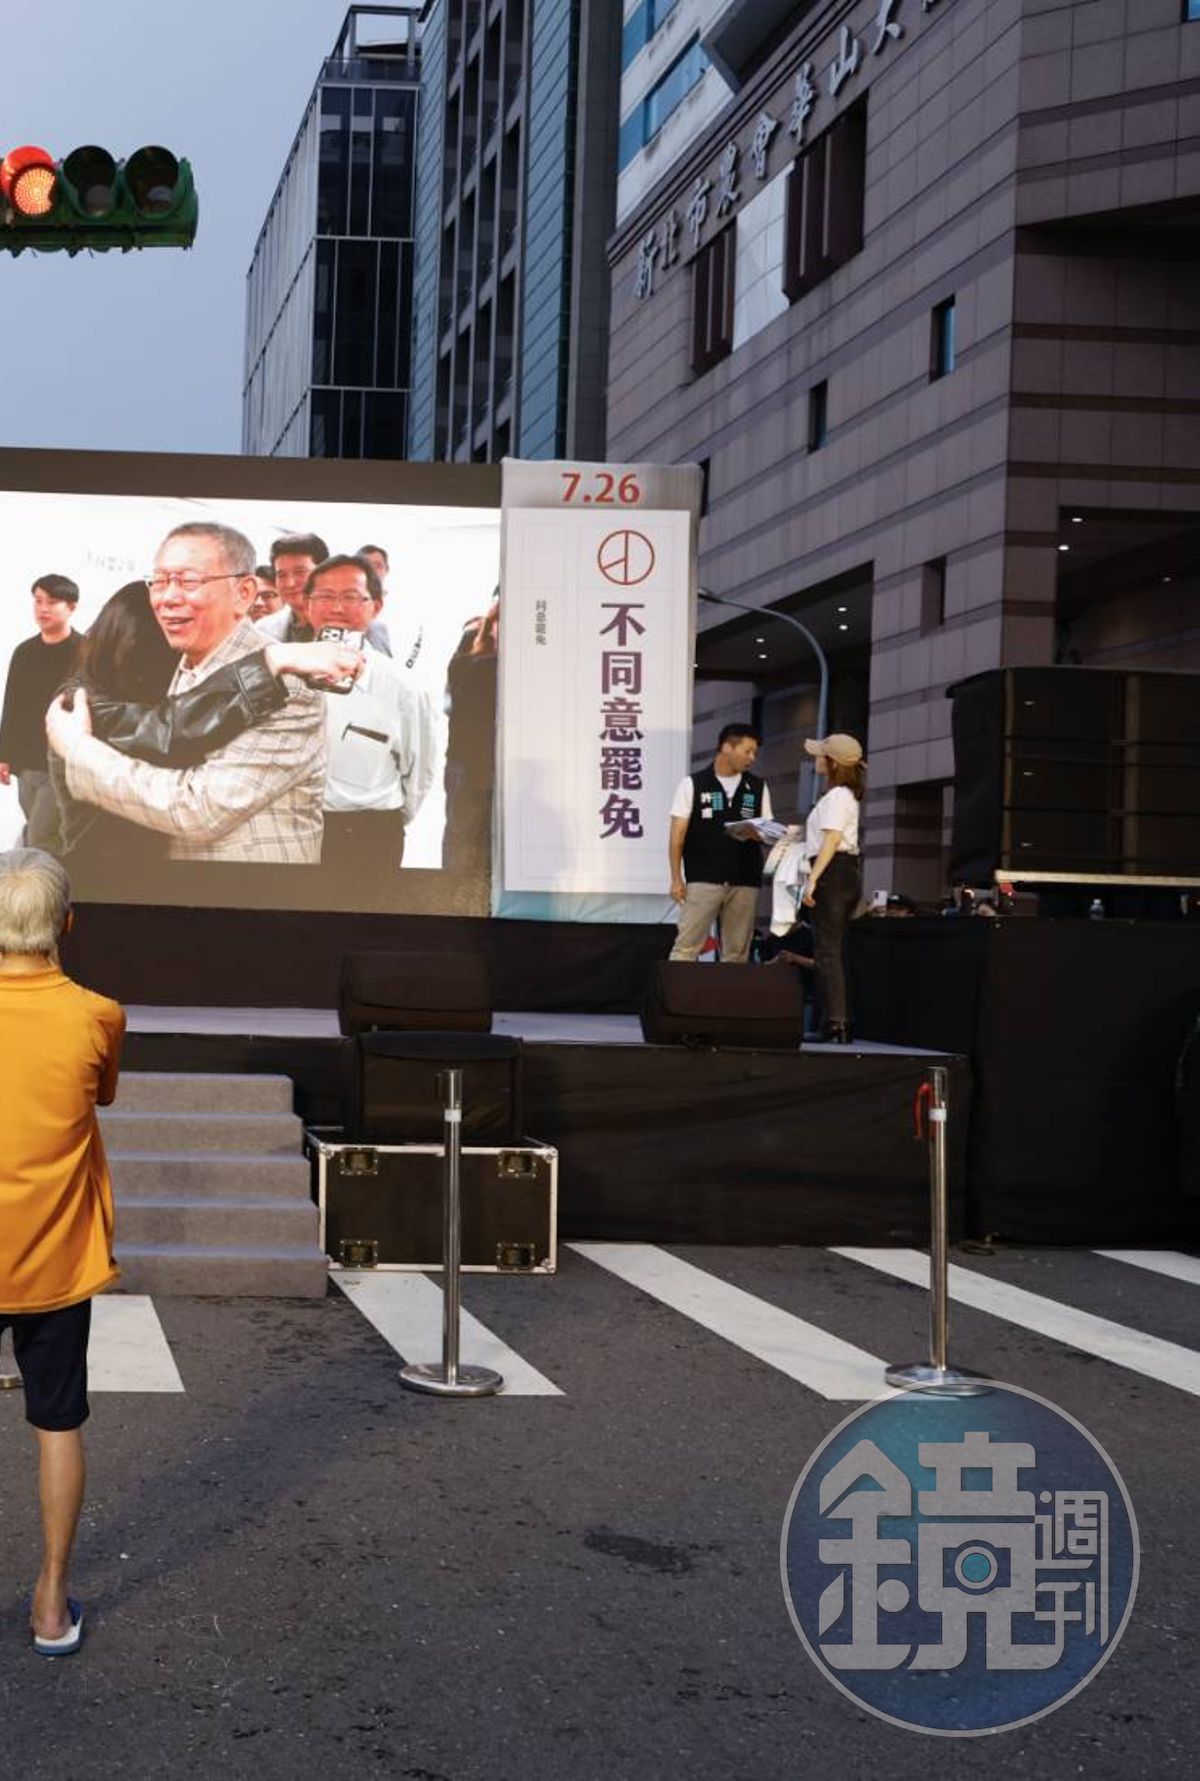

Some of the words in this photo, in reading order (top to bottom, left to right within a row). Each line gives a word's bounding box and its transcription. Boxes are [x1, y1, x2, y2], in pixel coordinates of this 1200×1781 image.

[561, 473, 640, 503] 7.26
[599, 603, 646, 839] 不同意罷免
